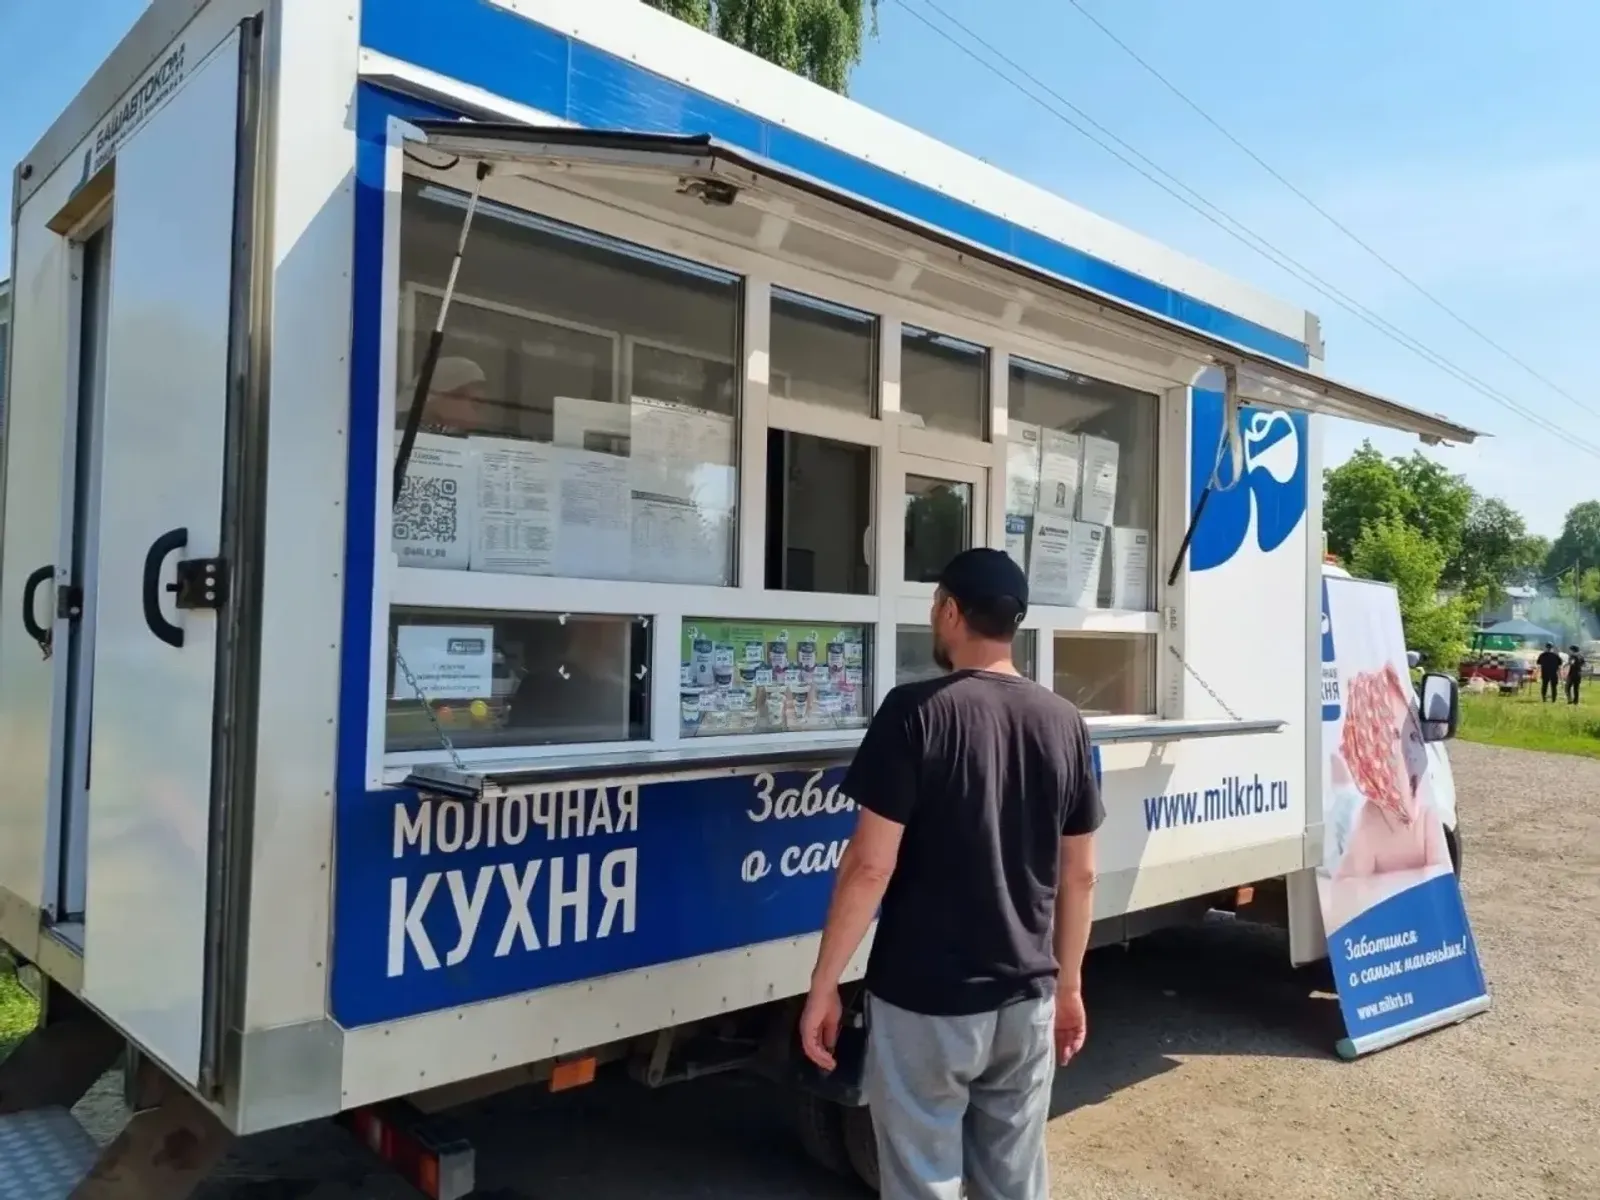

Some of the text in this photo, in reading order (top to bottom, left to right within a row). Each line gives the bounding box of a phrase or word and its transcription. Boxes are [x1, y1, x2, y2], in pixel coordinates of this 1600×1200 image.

[393, 784, 638, 859] МОЛОЧНАЯ
[1144, 773, 1289, 833] www.milkrb.ru
[741, 849, 772, 883] о
[386, 846, 639, 978] КУХНЯ
[1344, 930, 1419, 960] Заботимся
[1349, 935, 1467, 987] о самых маленьких!
[1356, 992, 1414, 1021] www.milkrb.ru
